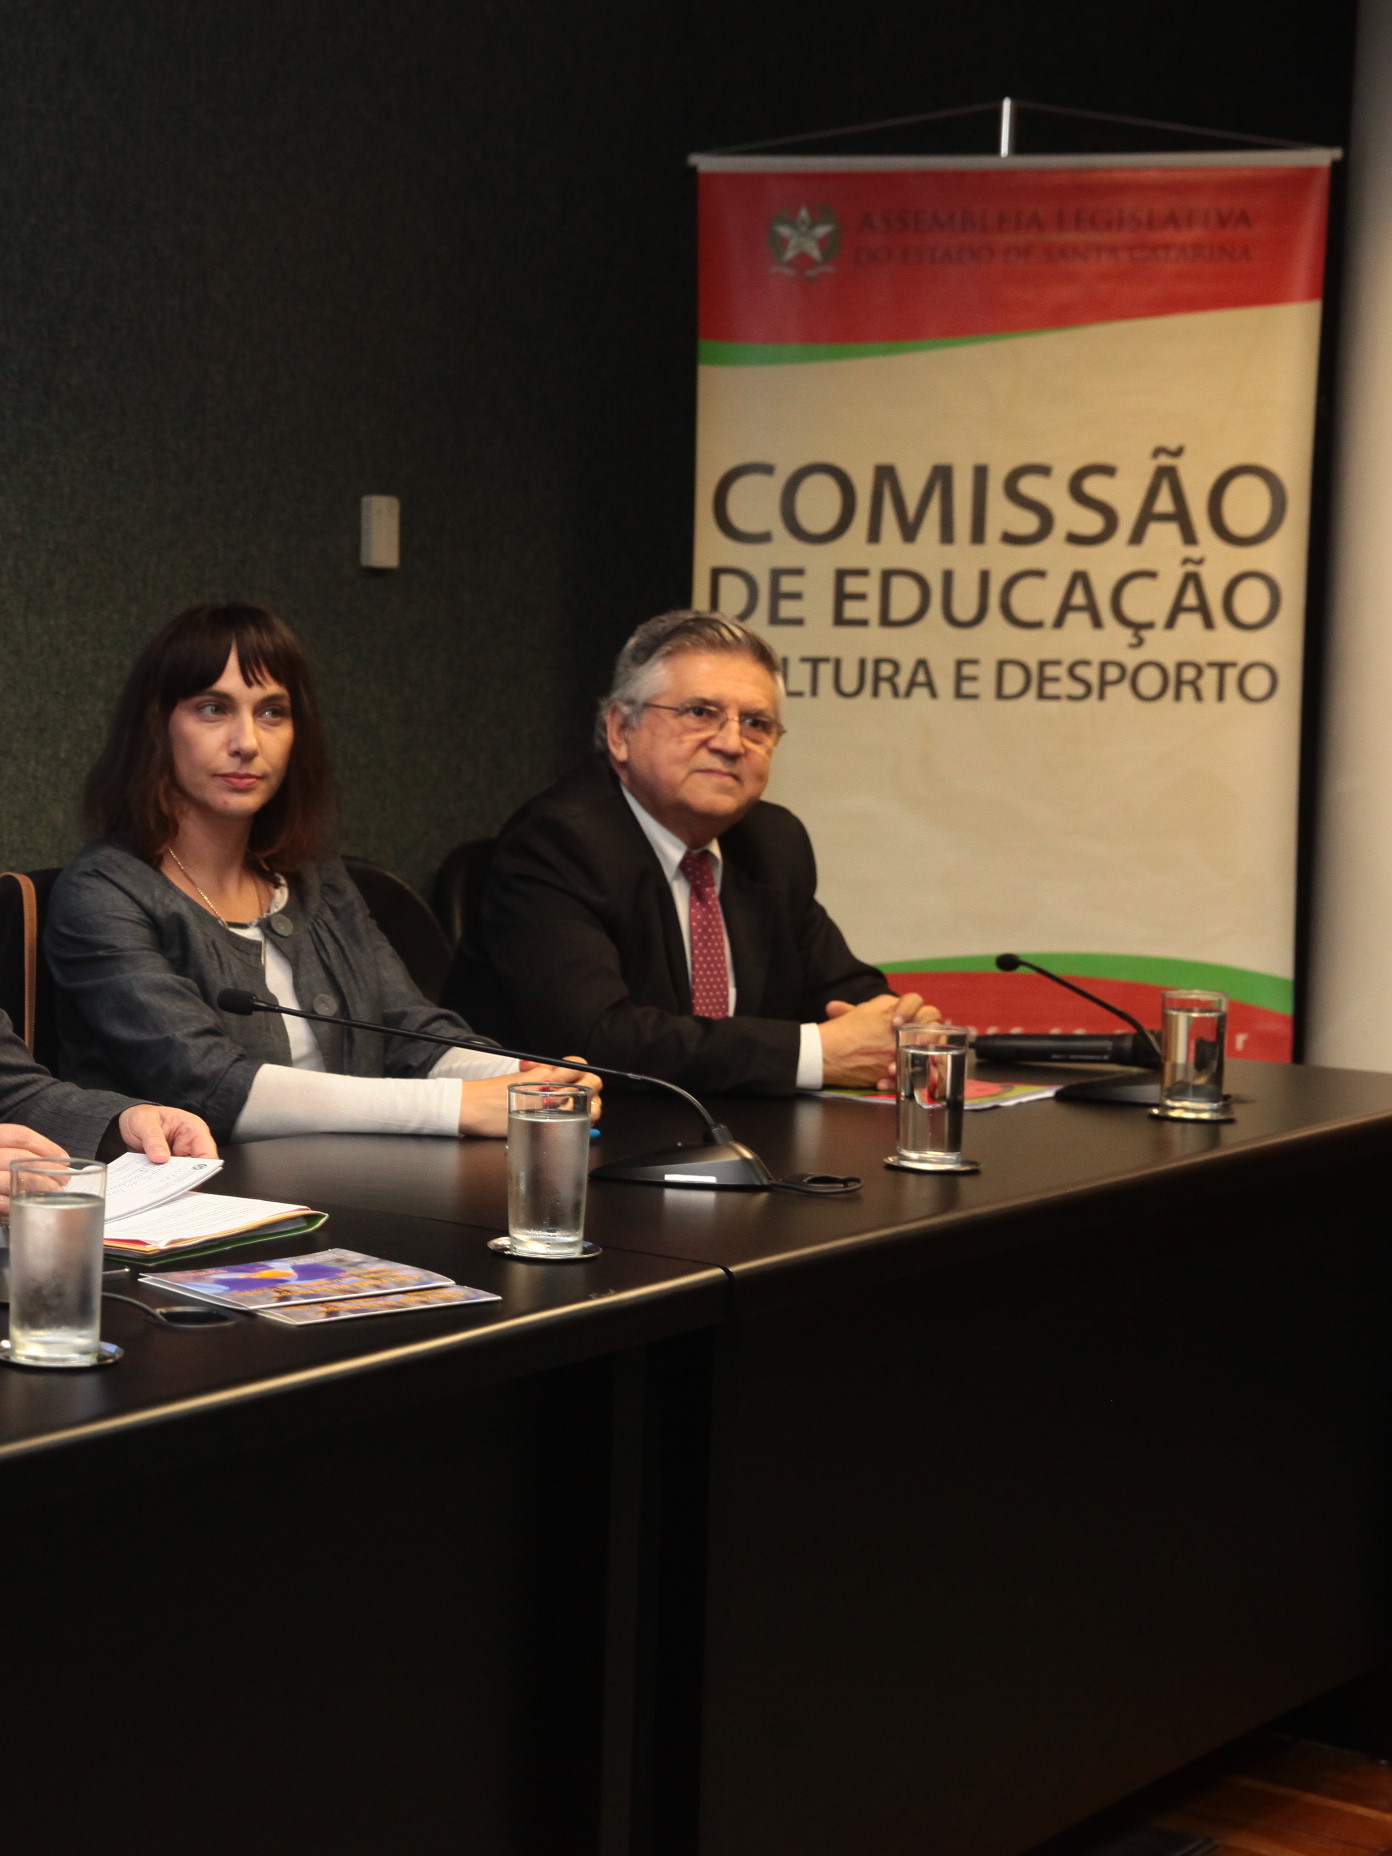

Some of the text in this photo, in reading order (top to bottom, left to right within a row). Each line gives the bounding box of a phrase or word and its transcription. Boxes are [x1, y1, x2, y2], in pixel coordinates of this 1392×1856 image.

[1055, 207, 1254, 232] LEGISLATIVA
[712, 445, 1288, 547] COMISSÃO
[709, 556, 1282, 648] DE EDUCAÇÃO
[781, 656, 1279, 703] LTURA E DESPORTO
